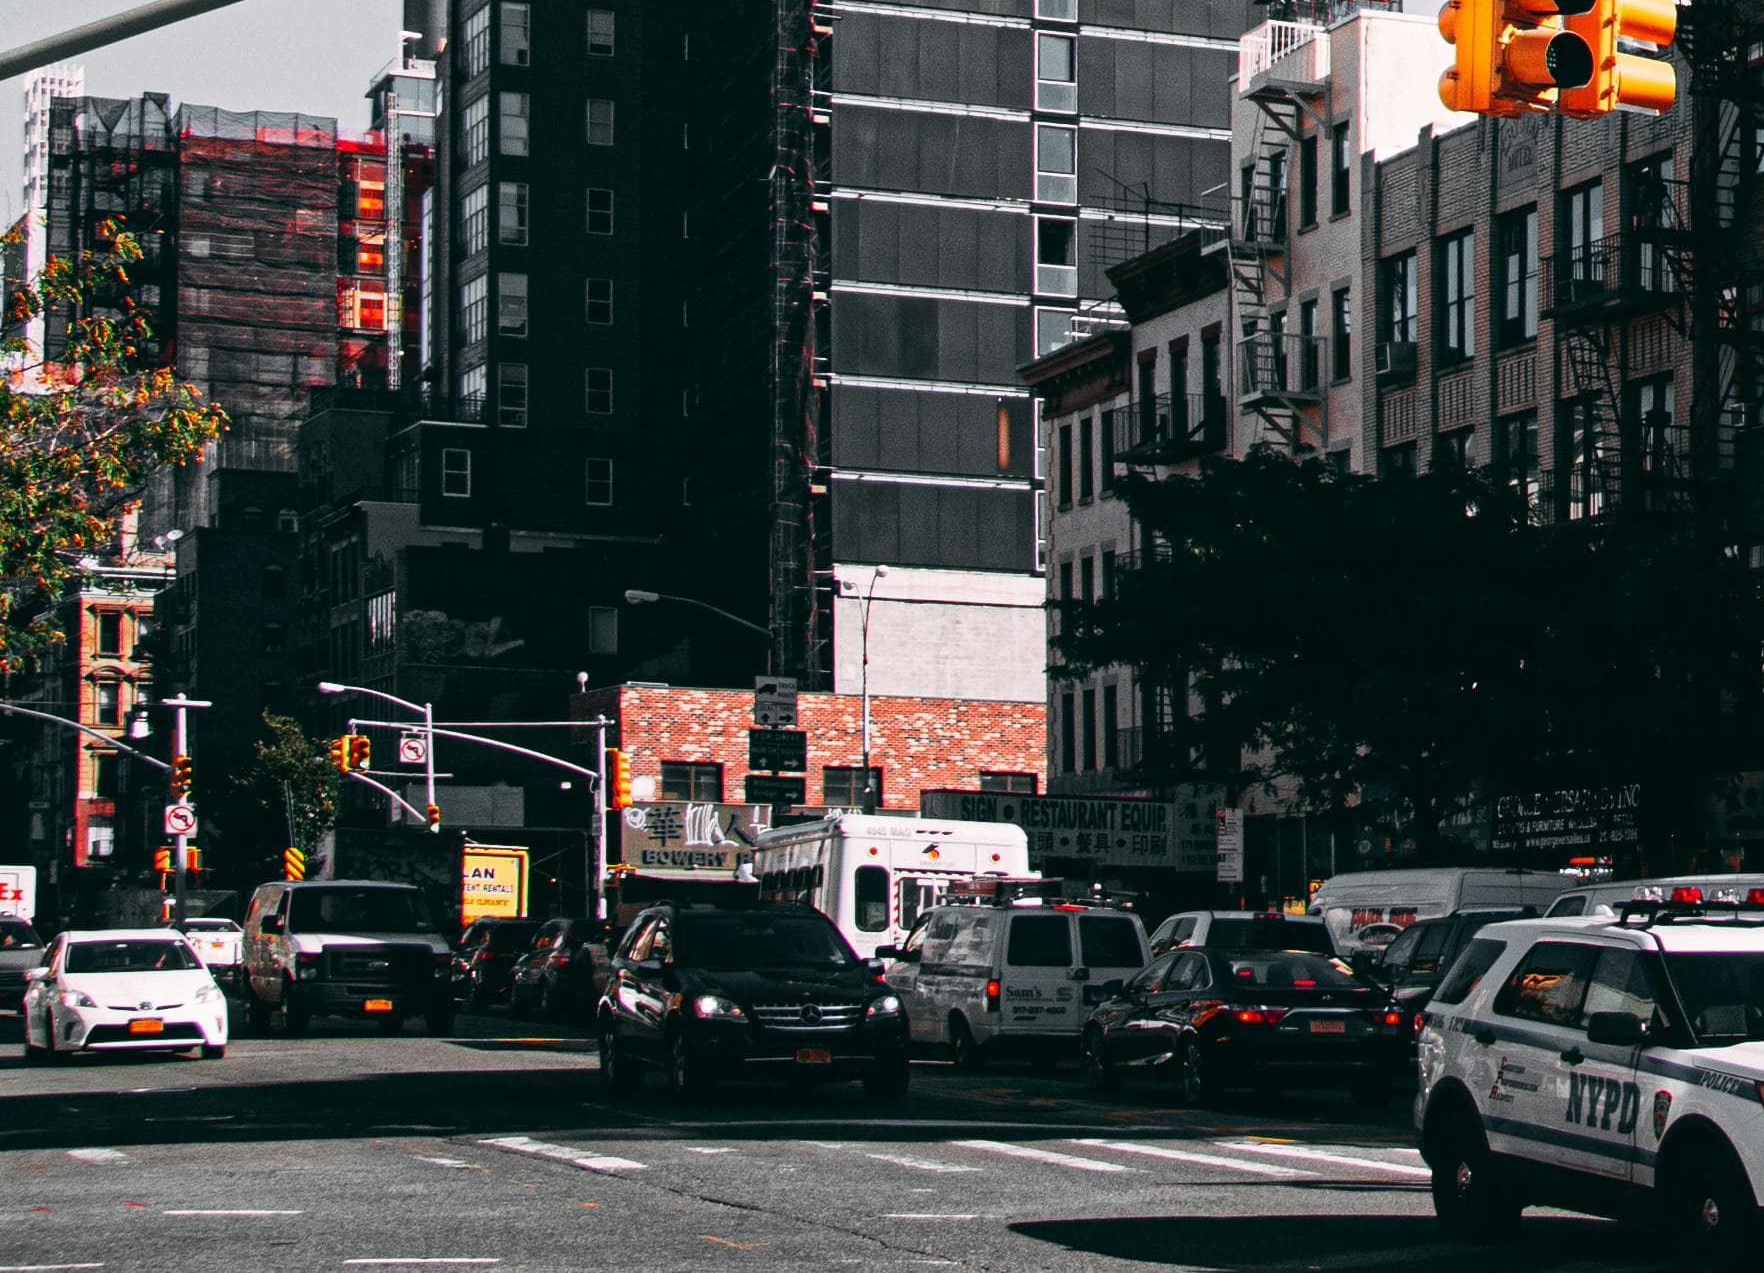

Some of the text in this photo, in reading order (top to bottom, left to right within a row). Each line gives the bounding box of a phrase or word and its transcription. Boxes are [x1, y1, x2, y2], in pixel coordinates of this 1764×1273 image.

[961, 796, 998, 821] SIGN
[1019, 799, 1118, 831] RESTAURANT
[1120, 803, 1167, 833] EQUIP.
[641, 849, 726, 867] BOWERY
[1006, 985, 1042, 998] Sam's
[1700, 1071, 1739, 1095] POLICE
[1565, 1071, 1641, 1135] NYPD
